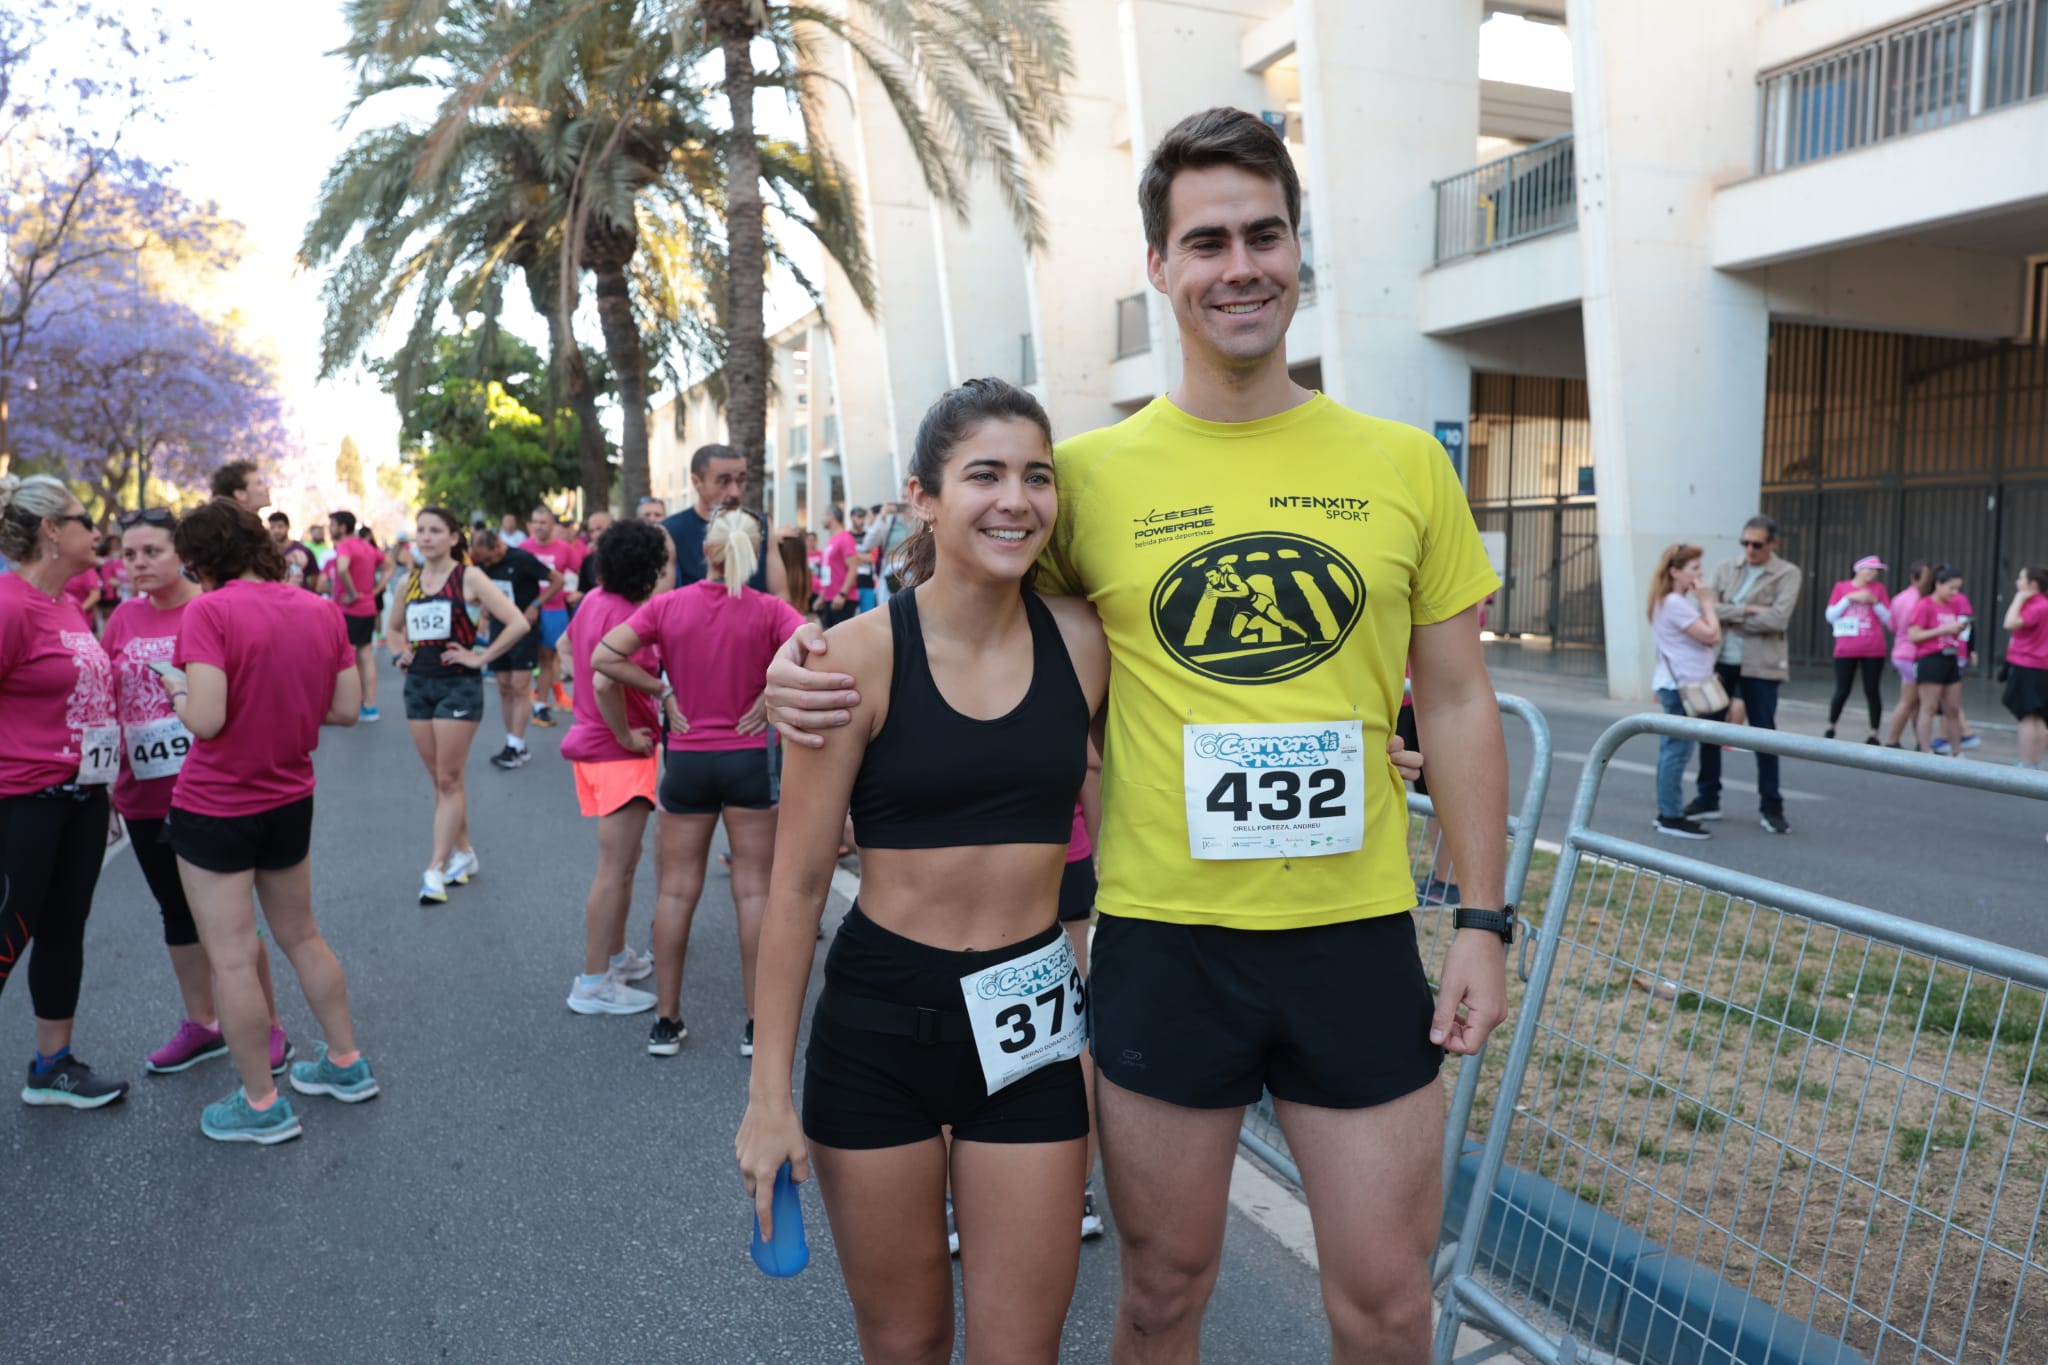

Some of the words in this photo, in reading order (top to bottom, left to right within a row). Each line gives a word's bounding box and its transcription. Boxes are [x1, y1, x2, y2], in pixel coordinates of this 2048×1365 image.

[1269, 495, 1369, 510] INTENXITY
[1326, 509, 1371, 522] SPORT
[1135, 519, 1215, 539] POWERADE
[1158, 533, 1174, 545] para
[1175, 530, 1214, 542] deportistas
[412, 615, 444, 631] 152
[134, 737, 190, 763] 449
[1220, 733, 1320, 755] Carrera
[1206, 768, 1346, 822] 432
[1233, 824, 1257, 832] ORELL
[1292, 822, 1321, 830] ANDREU
[995, 967, 1085, 1054] 373
